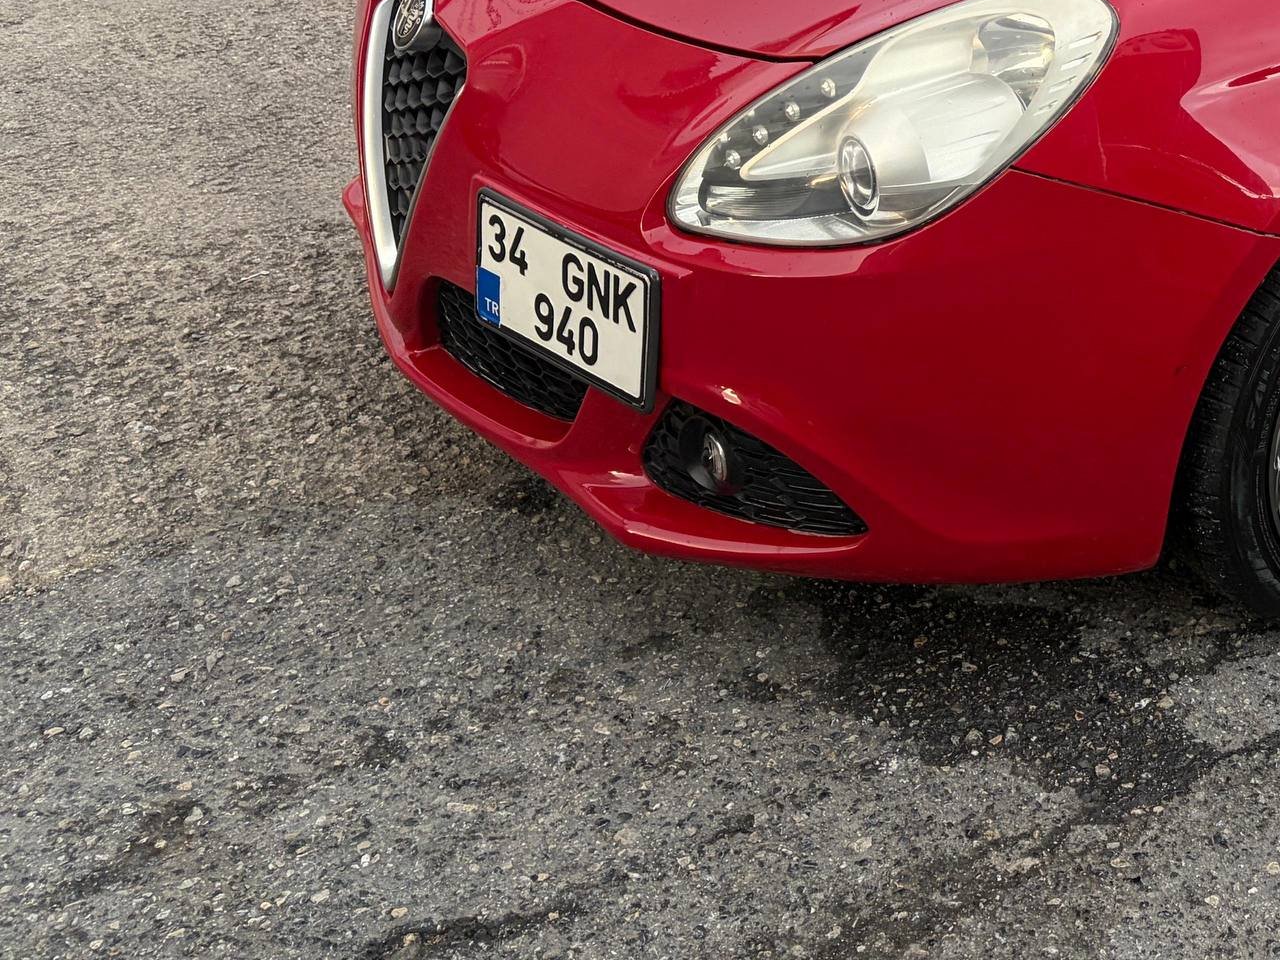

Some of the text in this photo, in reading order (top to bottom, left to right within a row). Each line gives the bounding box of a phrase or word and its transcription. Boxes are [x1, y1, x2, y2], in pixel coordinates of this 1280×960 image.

[484, 296, 499, 317] TR
[488, 214, 637, 333] 34 GNK
[534, 292, 599, 366] 940
